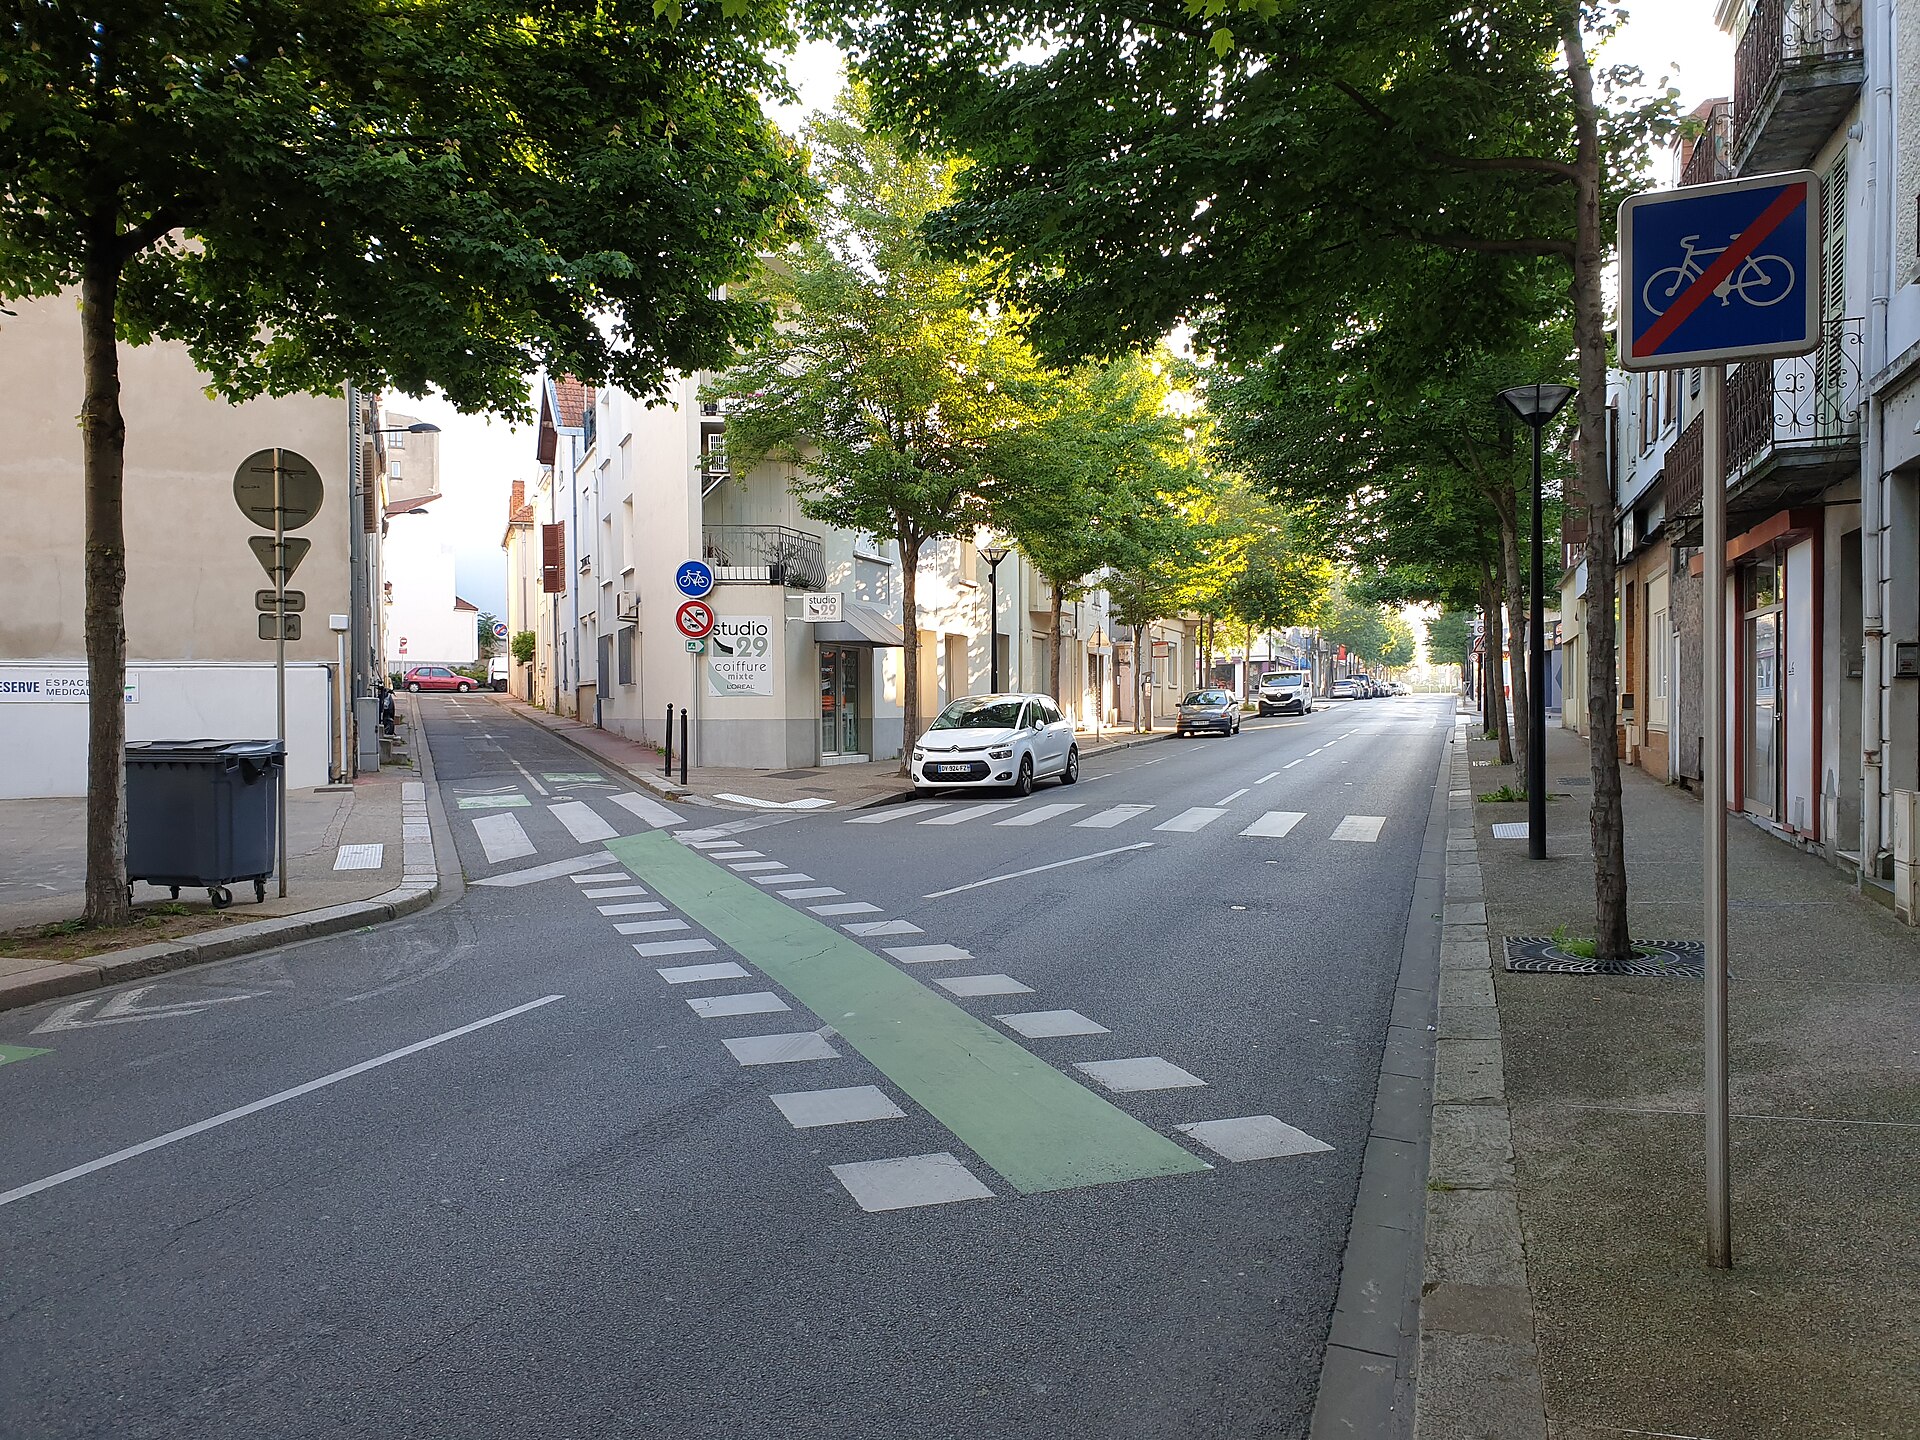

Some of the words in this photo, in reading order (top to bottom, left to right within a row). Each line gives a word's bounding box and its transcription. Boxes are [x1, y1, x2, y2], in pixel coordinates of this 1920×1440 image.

[808, 596, 837, 604] studio
[820, 604, 837, 616] 29
[713, 621, 768, 636] studio
[736, 636, 768, 657] 29
[714, 660, 767, 672] coiffure
[727, 672, 754, 680] mixte
